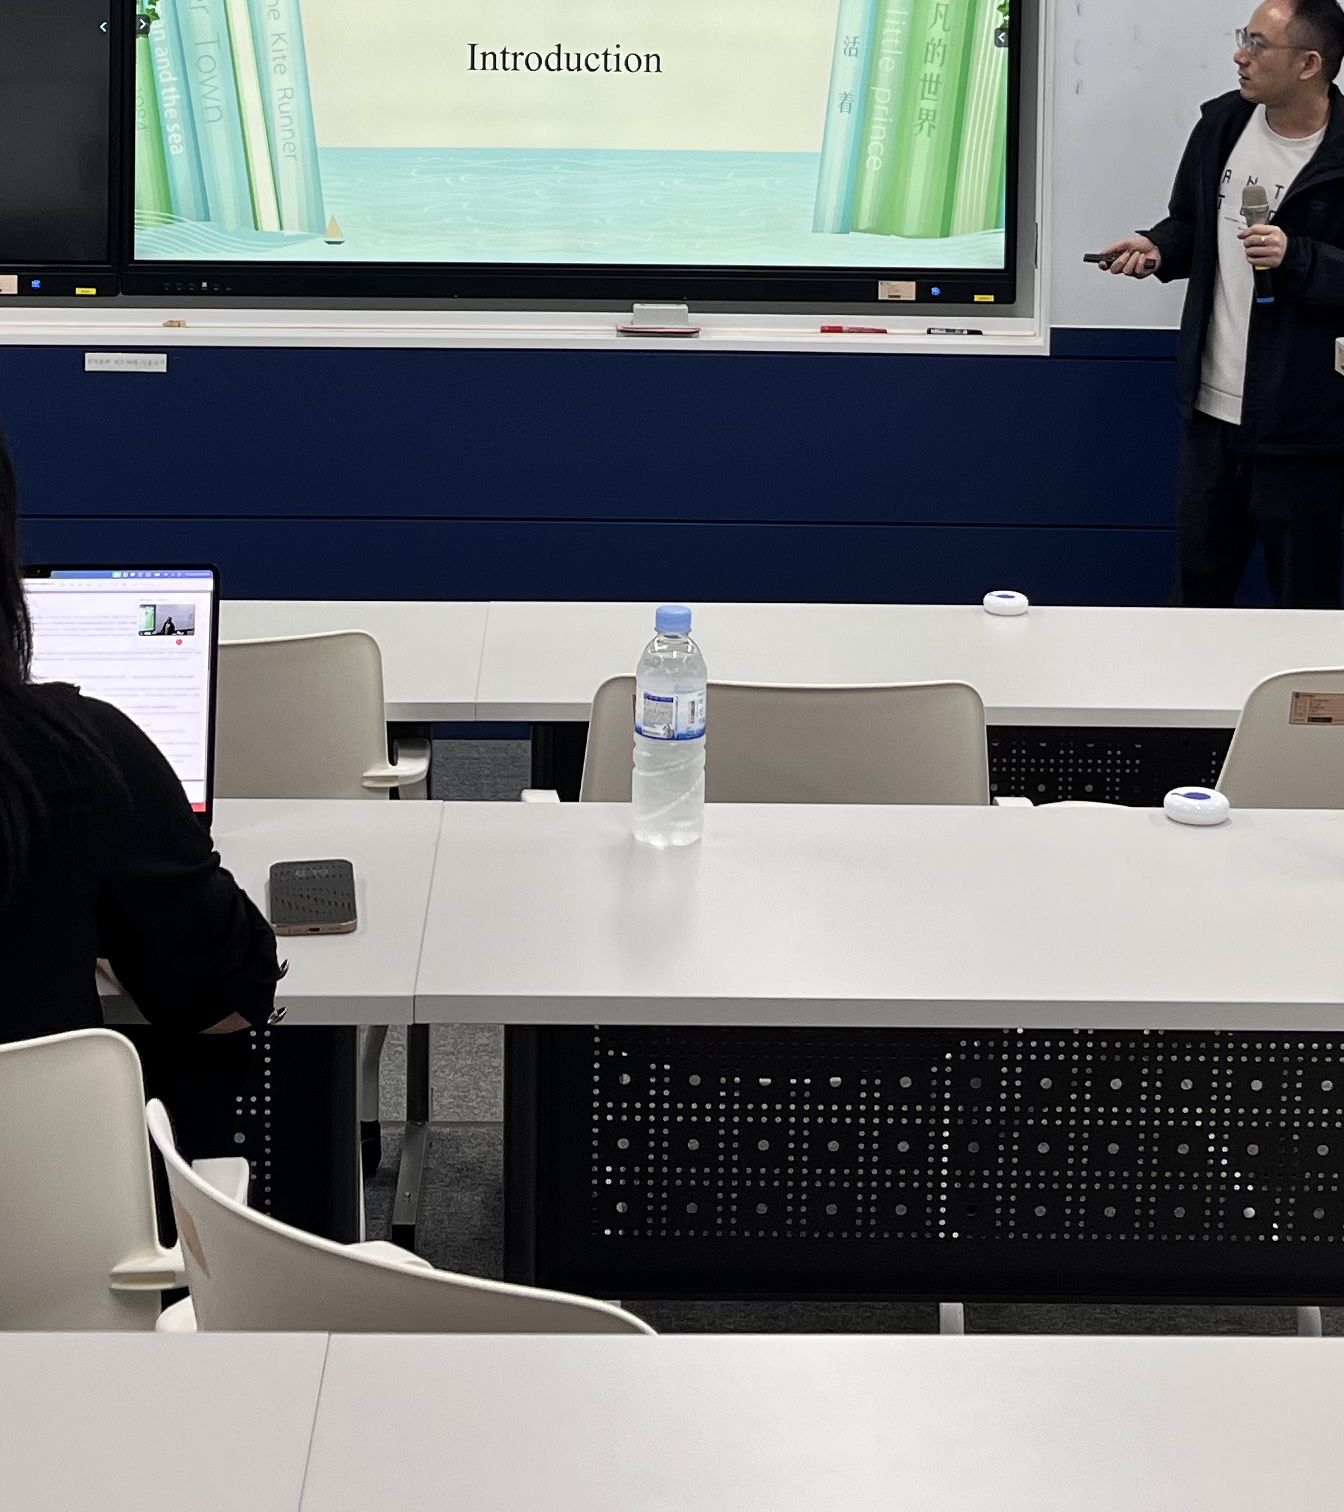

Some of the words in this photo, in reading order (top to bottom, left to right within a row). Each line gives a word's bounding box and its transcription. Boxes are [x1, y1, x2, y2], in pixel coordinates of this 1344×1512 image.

[271, 32, 289, 75] Kite
[467, 43, 663, 73] Introduction
[878, 9, 909, 73] little
[155, 47, 177, 82] and
[194, 32, 223, 123] Town
[161, 87, 181, 118] the
[167, 123, 184, 156] sea
[277, 88, 298, 161] Runner
[865, 85, 894, 172] prince
